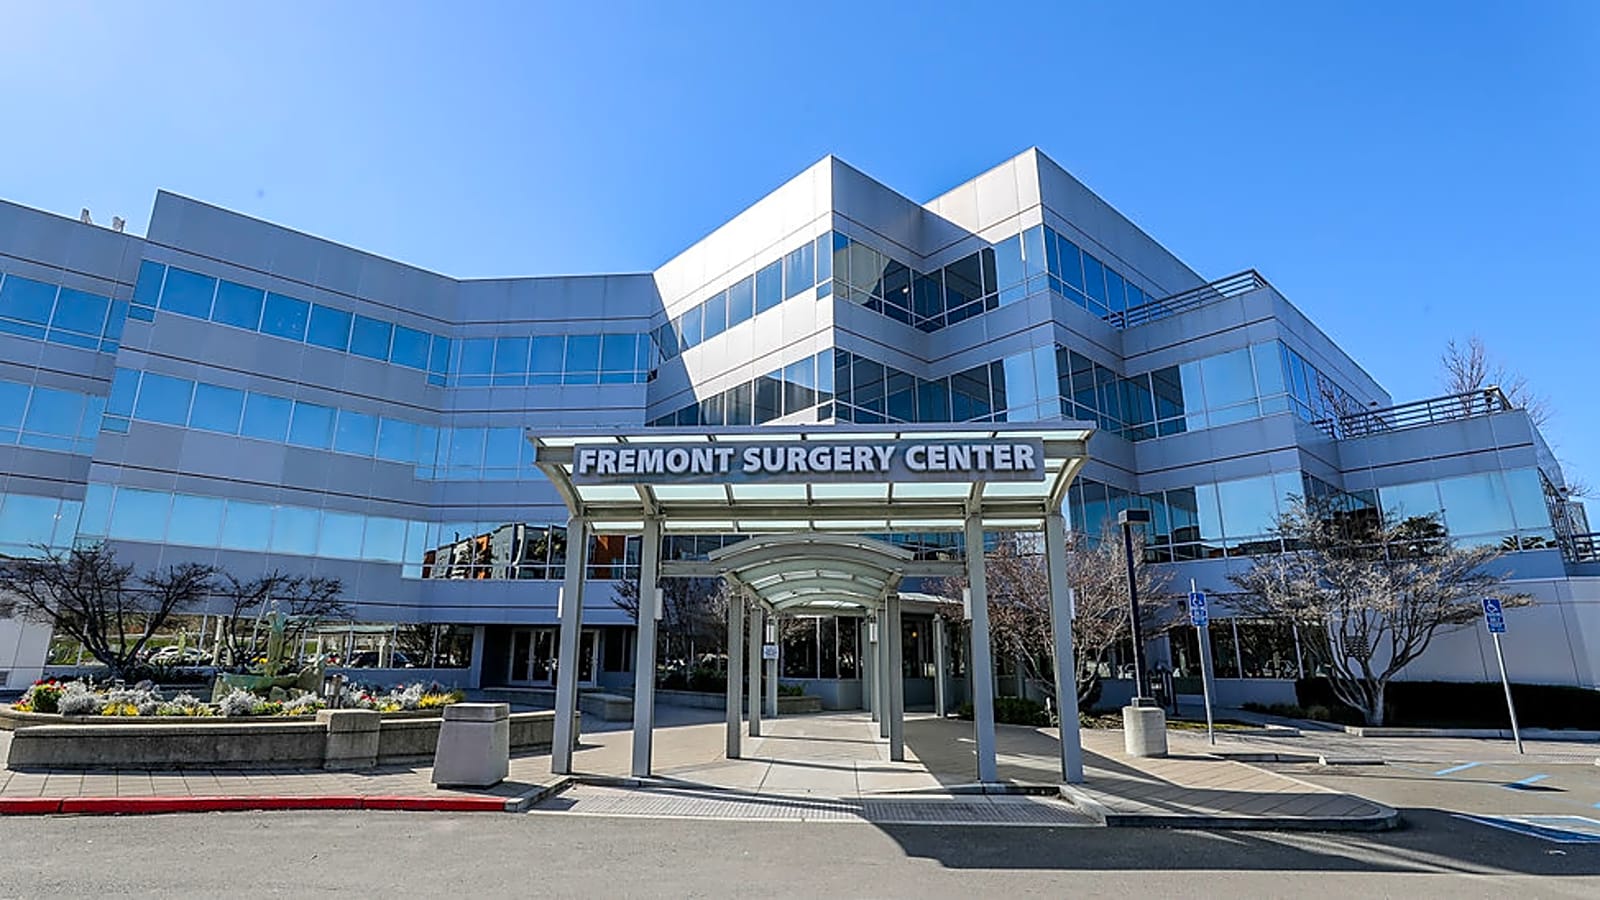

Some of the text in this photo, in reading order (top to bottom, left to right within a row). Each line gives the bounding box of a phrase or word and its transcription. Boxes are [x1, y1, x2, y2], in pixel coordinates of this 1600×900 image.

[579, 444, 1036, 474] FREMONT SURGERY CENTER
